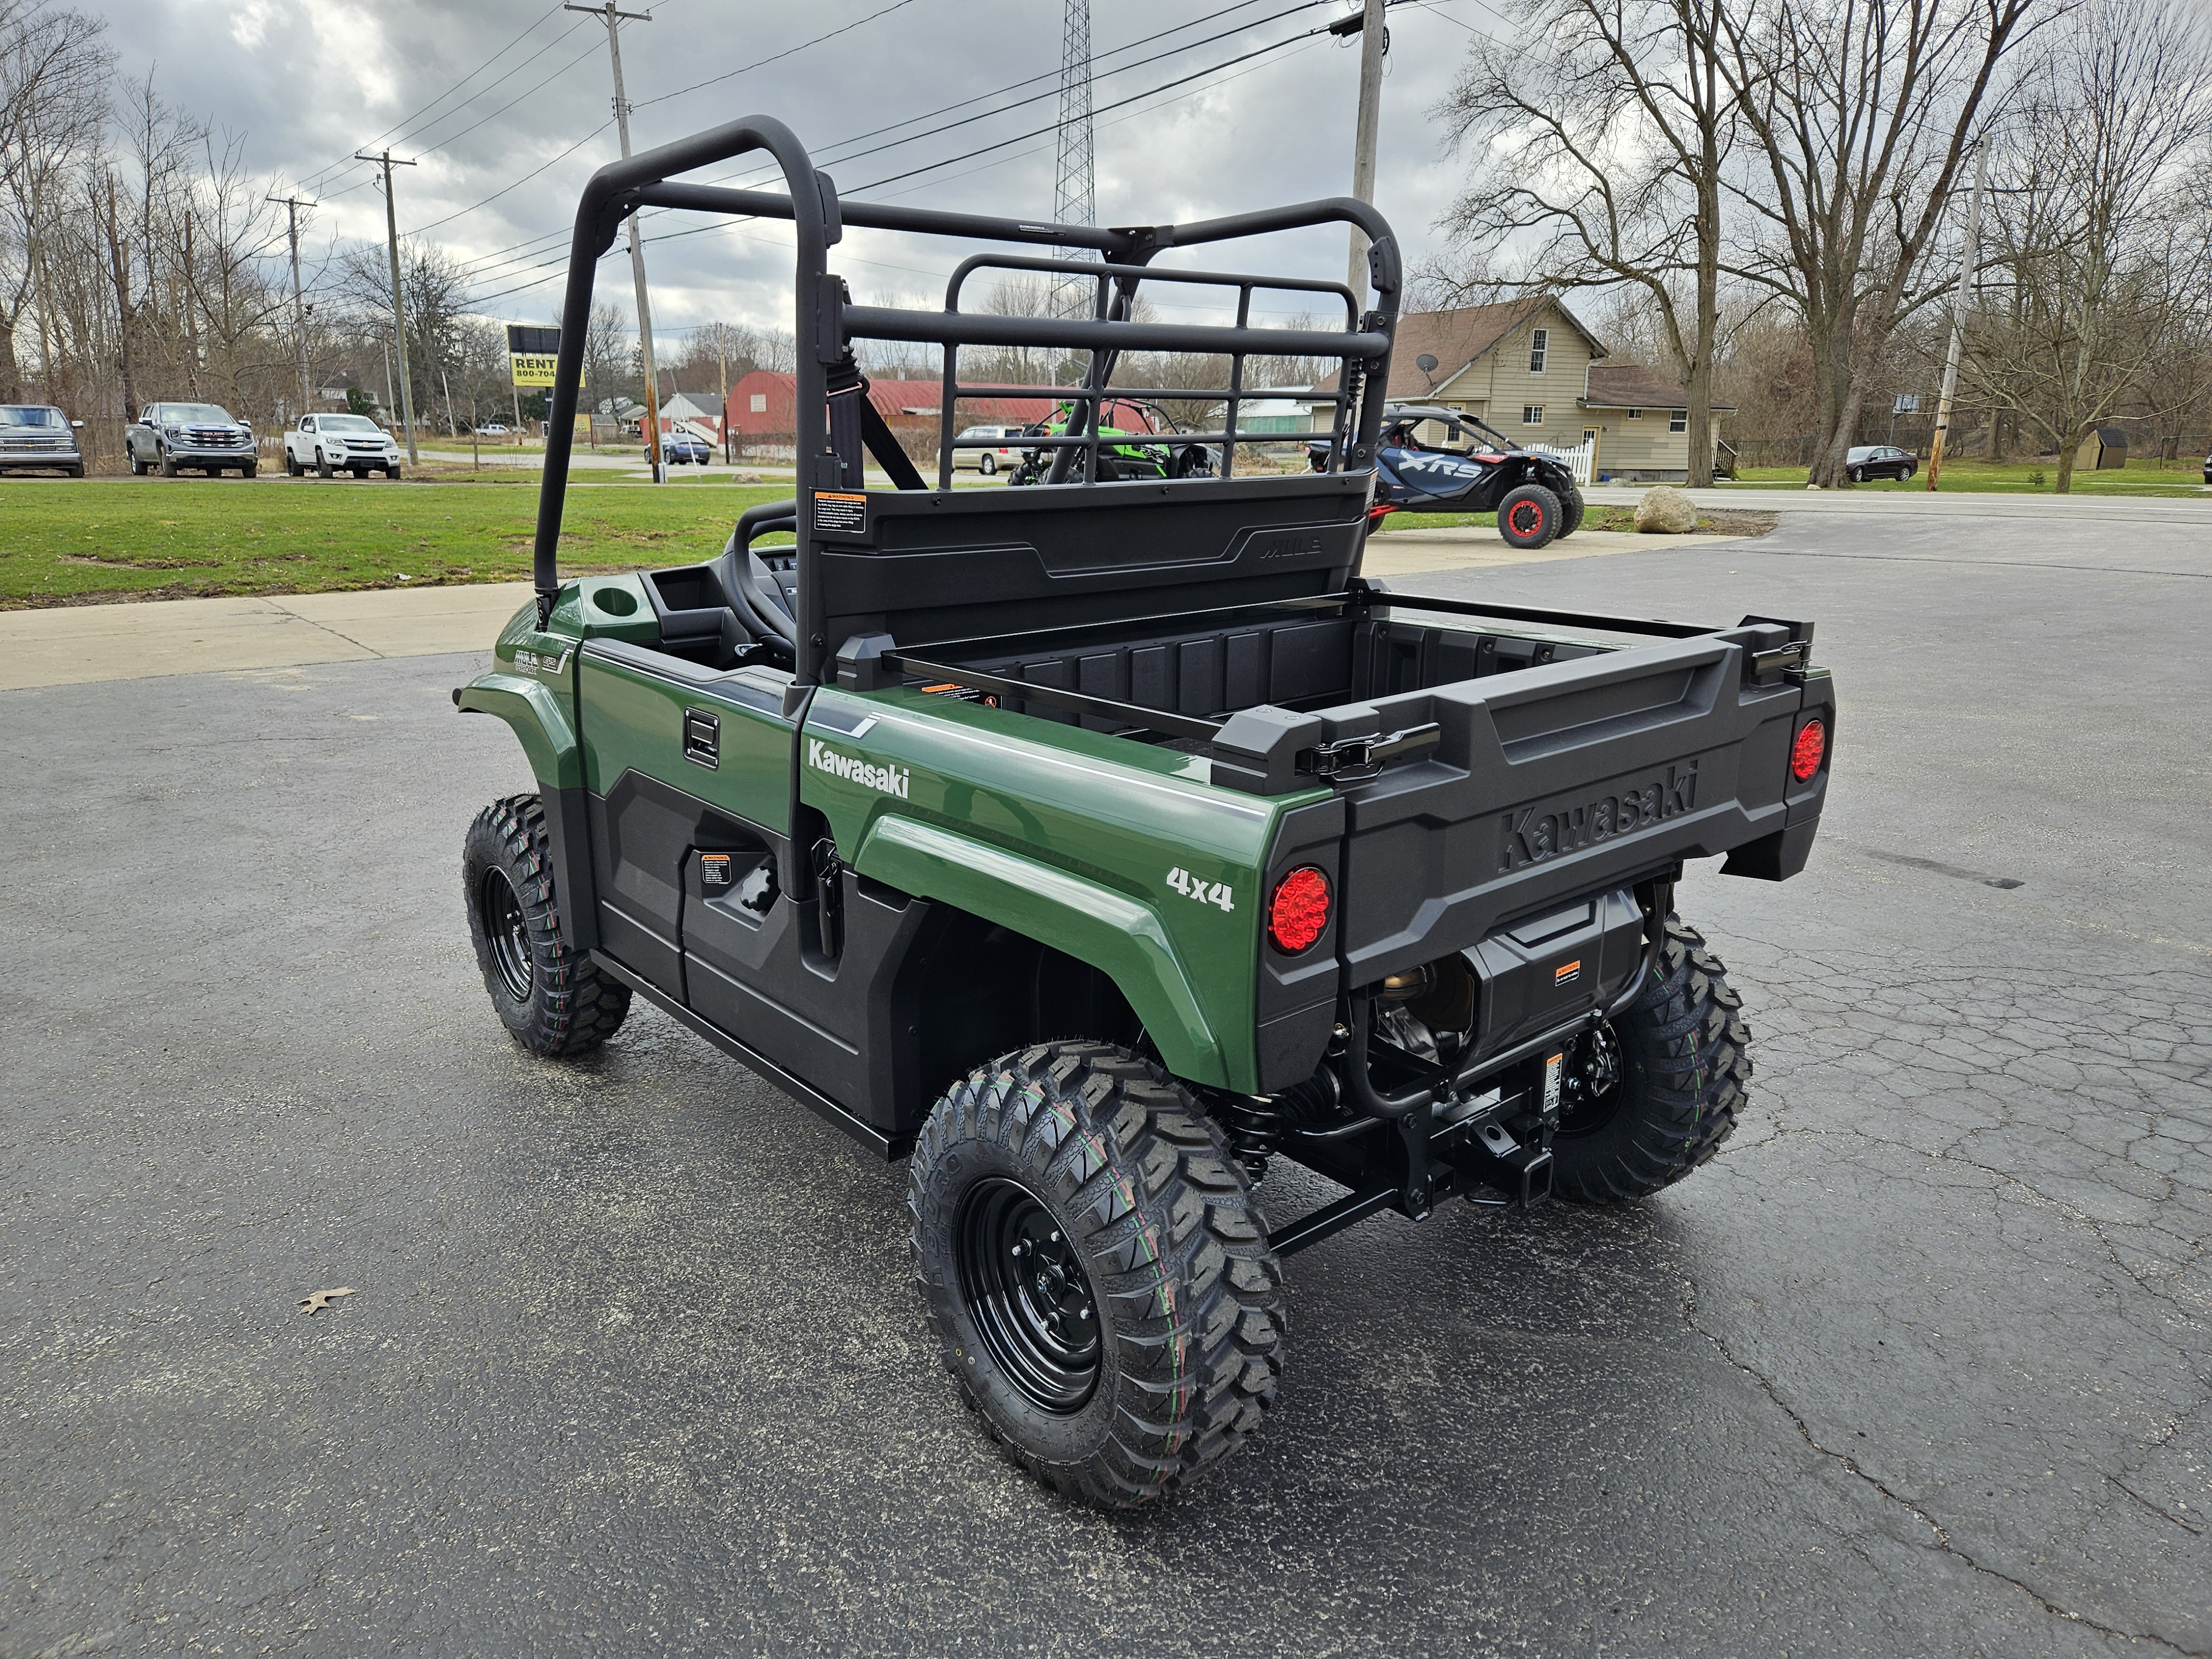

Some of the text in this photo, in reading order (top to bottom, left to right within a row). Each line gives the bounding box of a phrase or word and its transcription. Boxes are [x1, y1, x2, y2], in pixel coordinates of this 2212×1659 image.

[515, 359, 555, 369] RENT
[1399, 449, 1483, 478] XRS
[809, 738, 909, 799] Kawasaki
[1498, 759, 1698, 873] Kawasaki
[1166, 867, 1235, 912] 4x4
